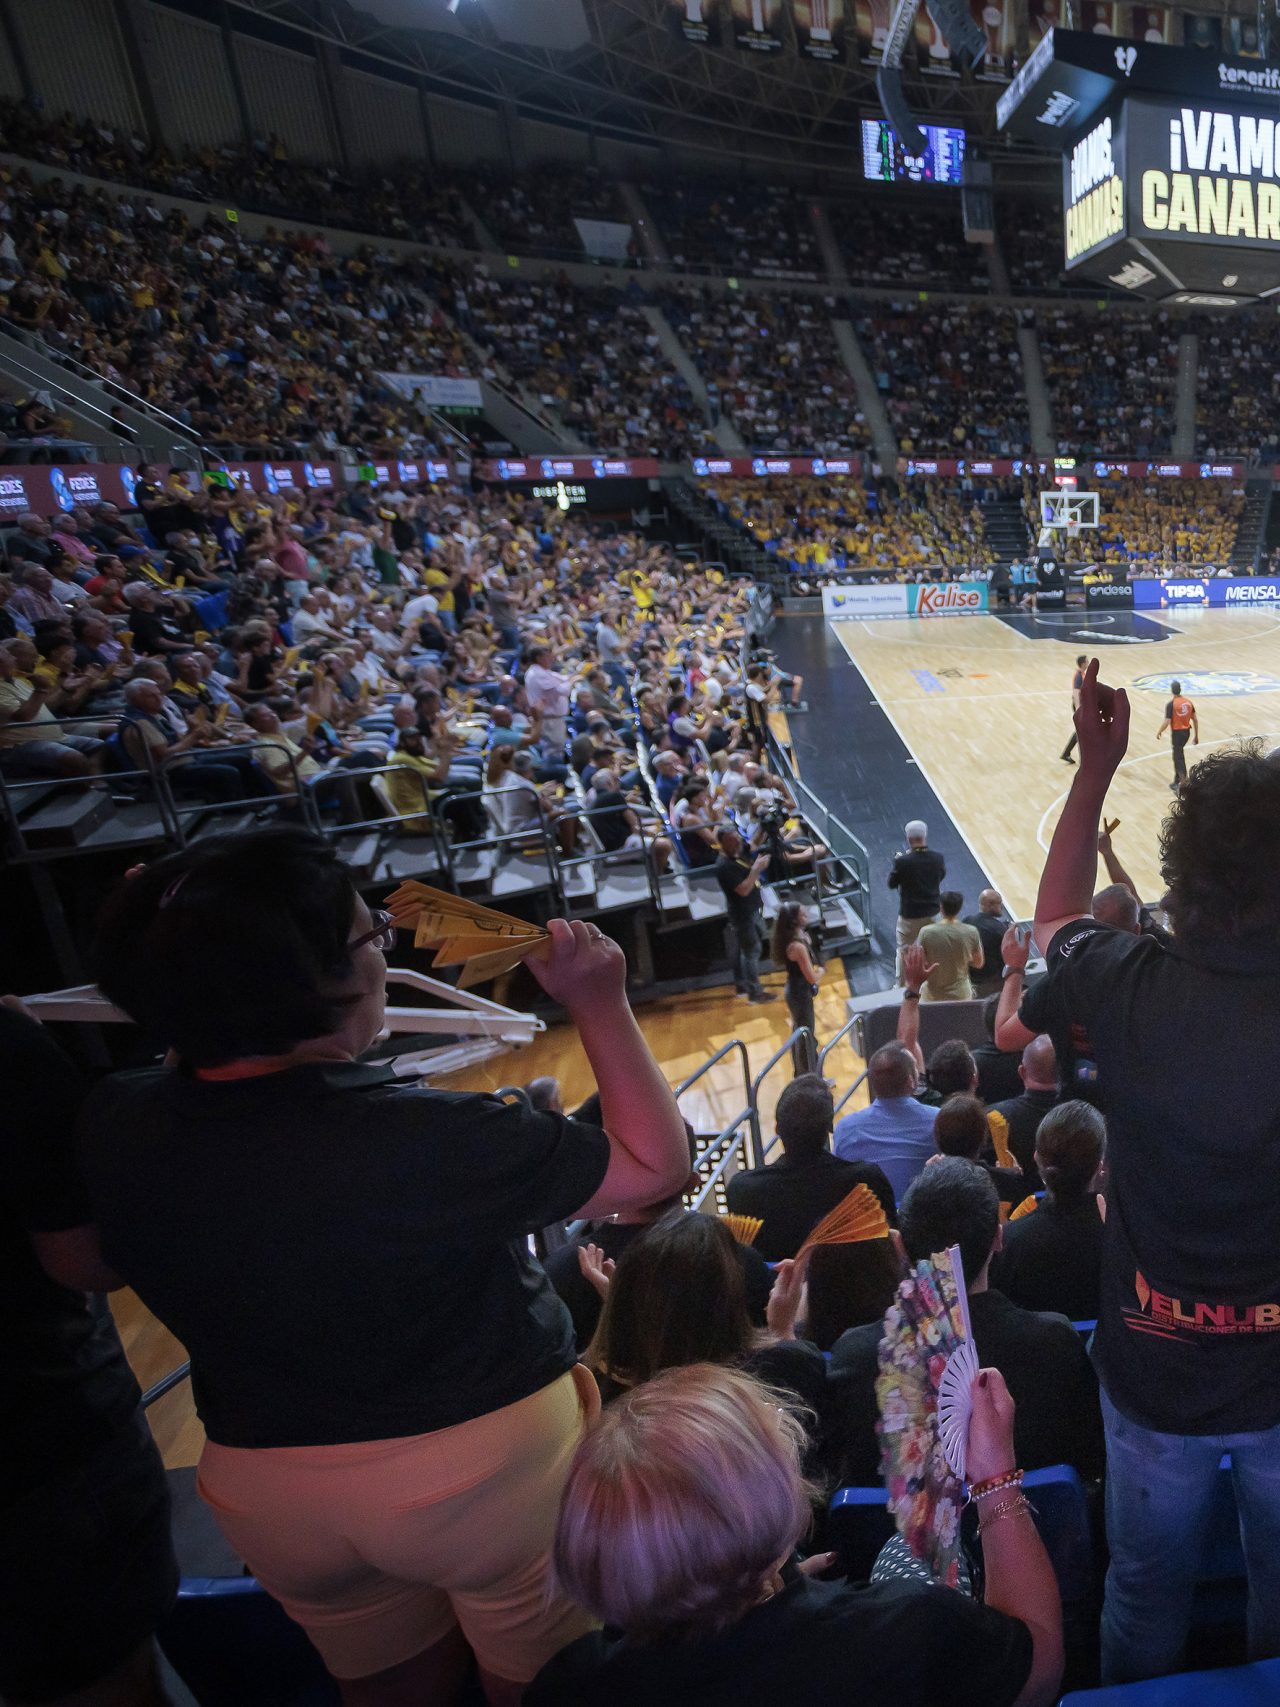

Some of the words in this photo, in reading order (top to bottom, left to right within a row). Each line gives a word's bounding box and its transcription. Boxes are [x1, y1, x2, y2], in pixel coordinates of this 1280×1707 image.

[917, 585, 980, 614] Kalise
[1089, 585, 1133, 596] endesa
[1165, 585, 1205, 598] TIPSA
[1151, 1311, 1238, 1334] DISTRIBUCIONES
[1237, 1325, 1254, 1334] DE
